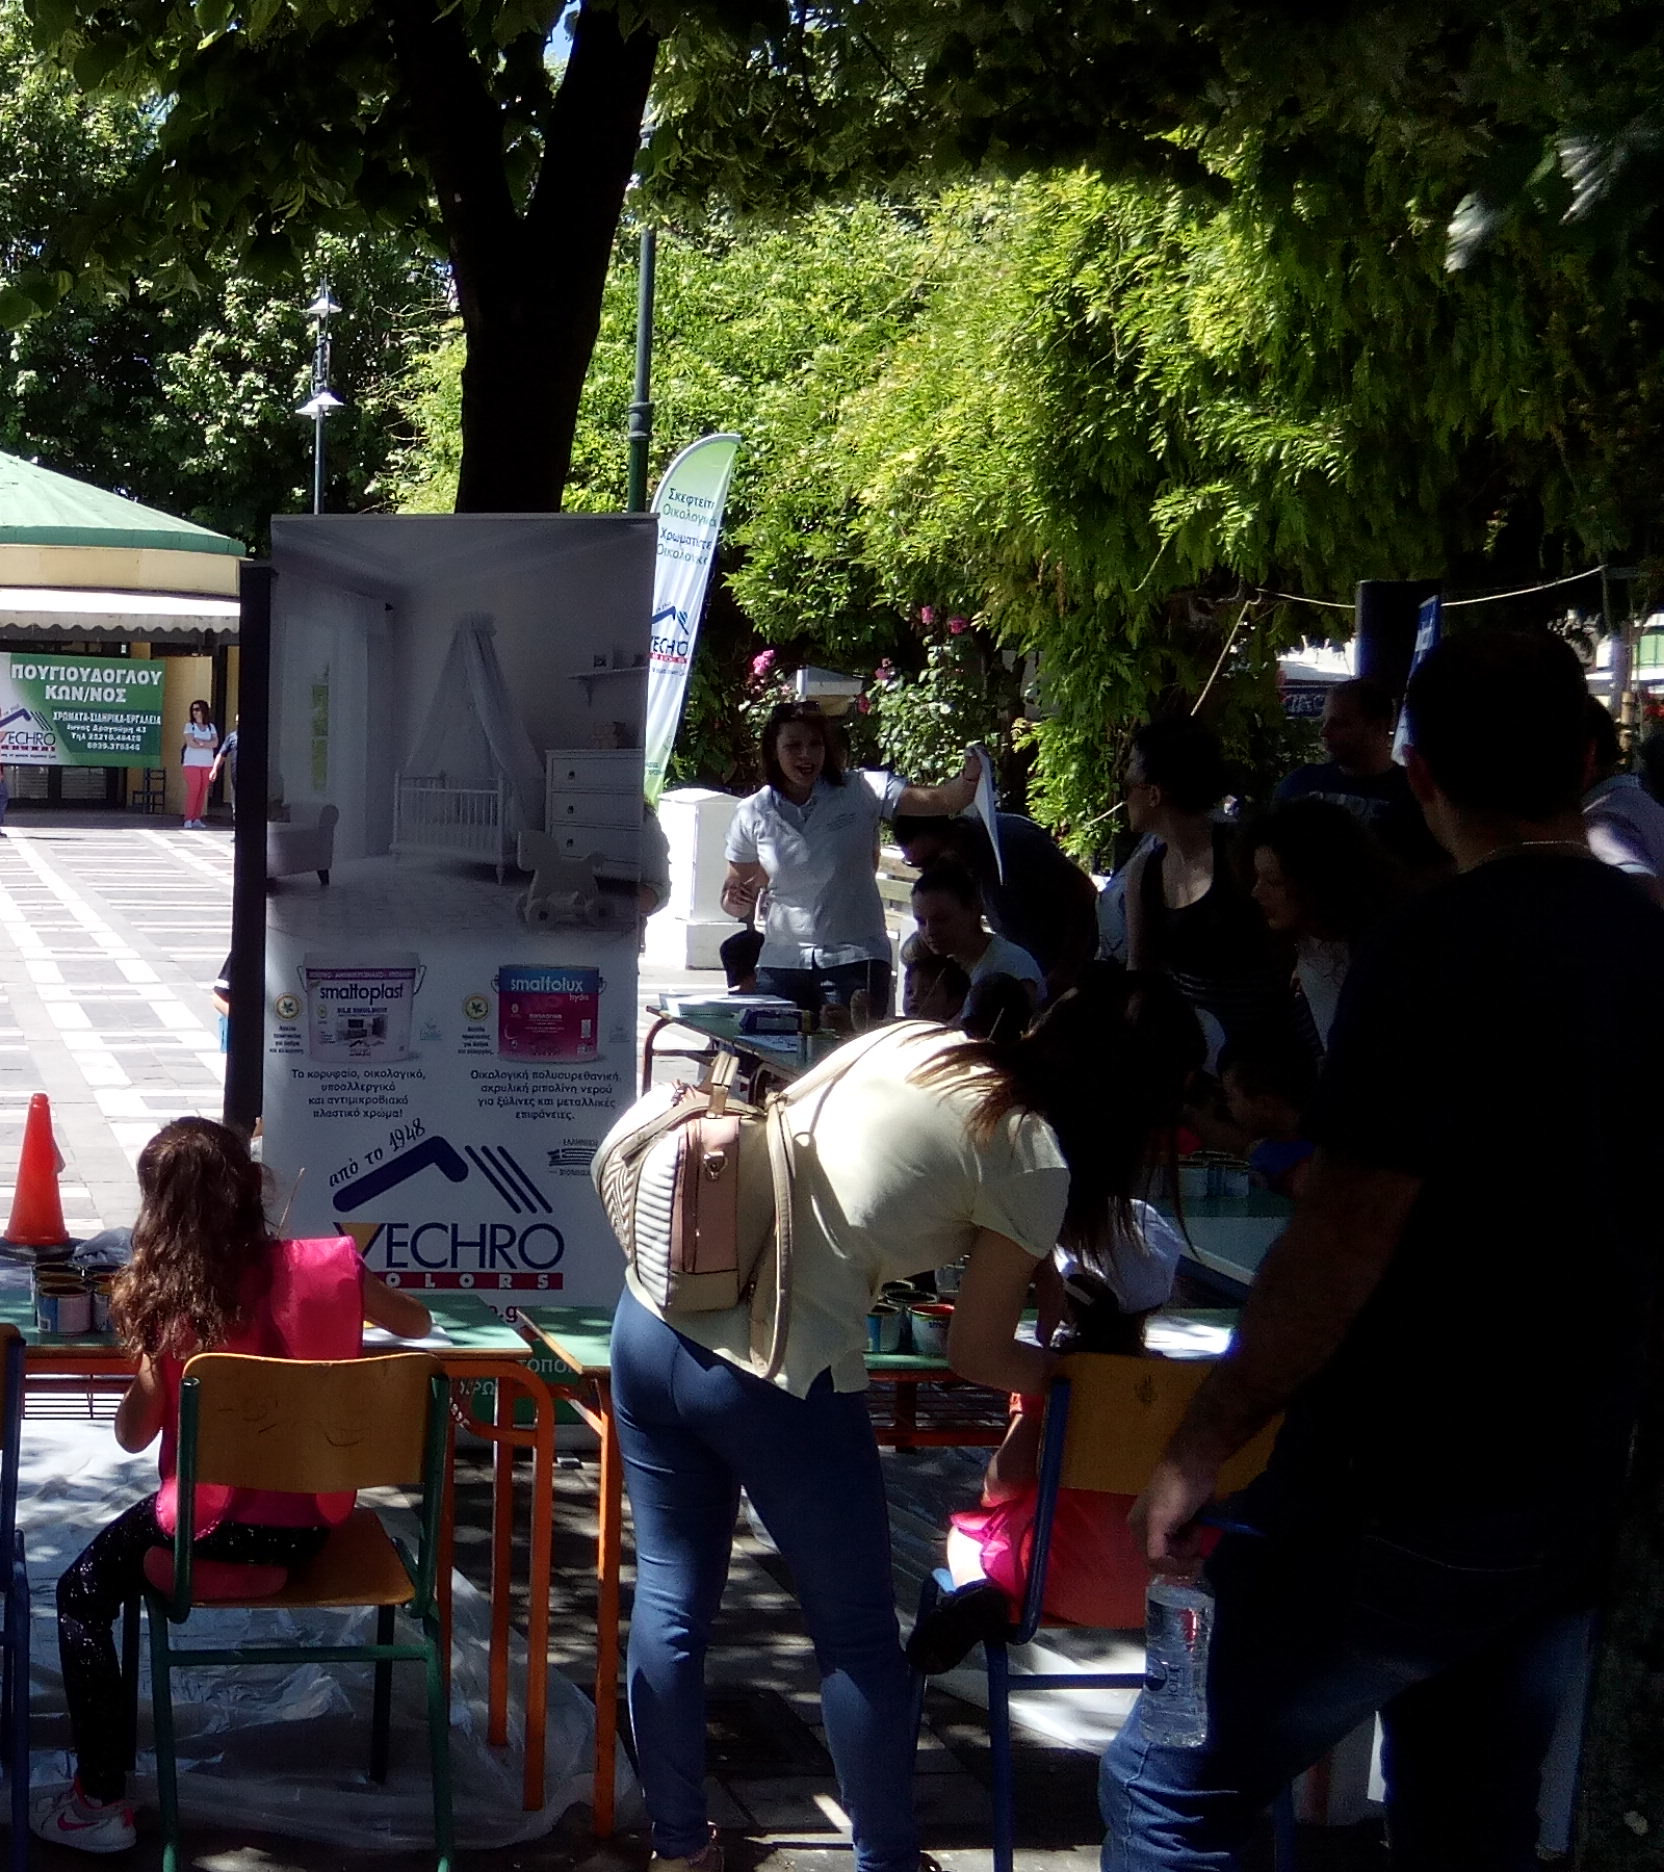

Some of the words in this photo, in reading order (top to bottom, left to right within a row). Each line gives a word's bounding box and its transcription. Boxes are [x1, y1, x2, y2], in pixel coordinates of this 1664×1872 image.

[11, 664, 163, 685] ΠΟΥΓΙΟΥΔΟΓΛΟΥ
[45, 685, 127, 702] ΚΩΝ/ΝΟΣ
[511, 976, 583, 992] smaltolux
[320, 983, 403, 1005] smaltoplast
[364, 1069, 426, 1081] οικολογικό,
[470, 1069, 529, 1082] Οικολογική
[321, 1081, 396, 1094] υποαλλεργικό
[480, 1082, 529, 1094] ακρυλική
[327, 1095, 409, 1106] αντιμικροβιακό
[313, 1108, 360, 1119] πλαστικό
[328, 1159, 359, 1187] από
[364, 1147, 384, 1166] το
[388, 1118, 426, 1152] 1948
[333, 1221, 565, 1270] VECHRO
[385, 1272, 549, 1289] OLORS
